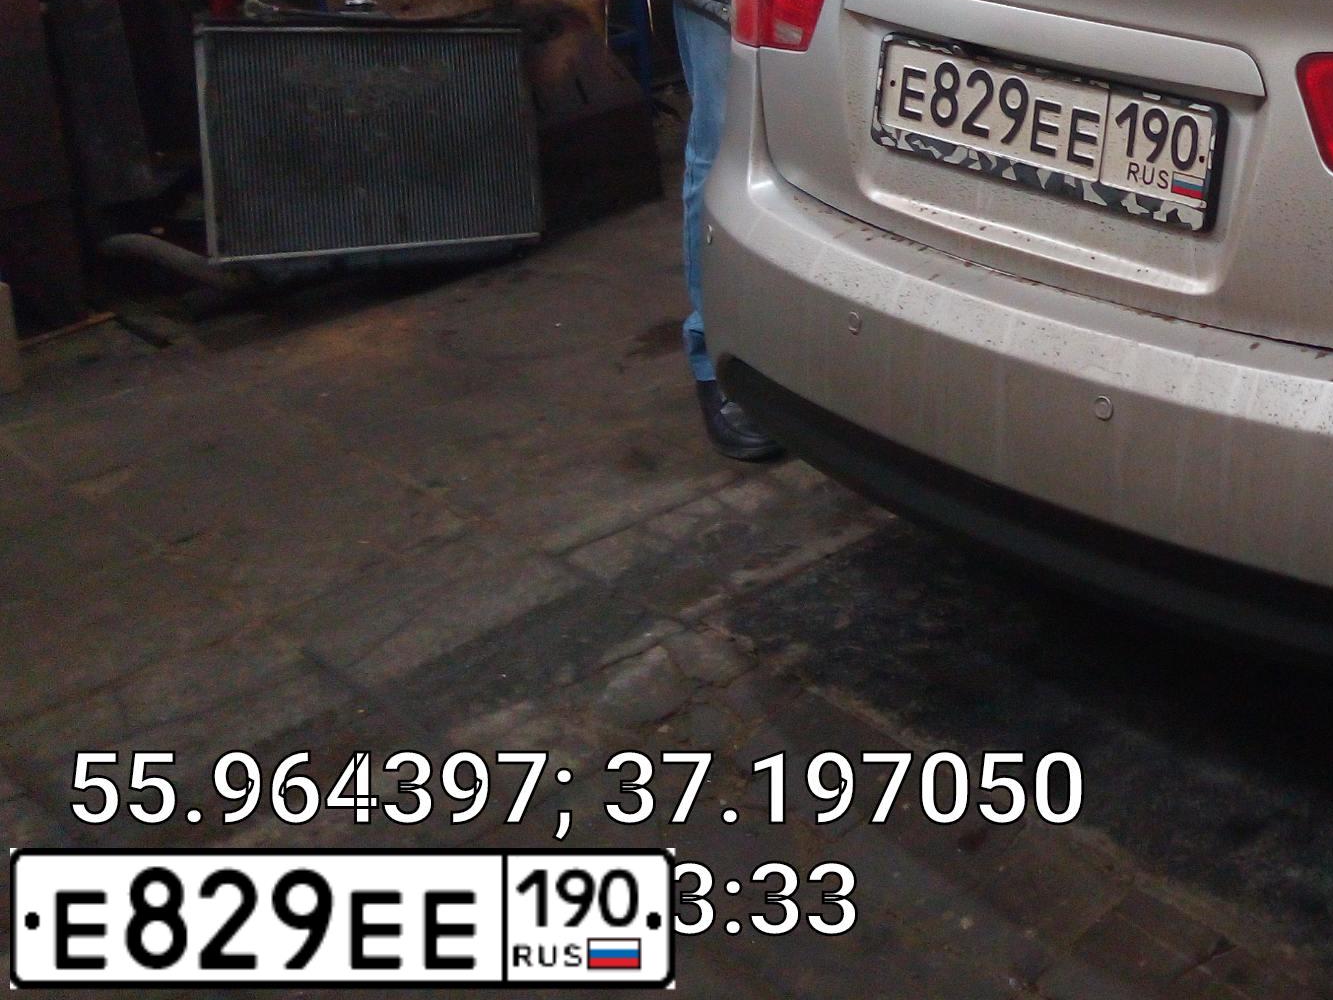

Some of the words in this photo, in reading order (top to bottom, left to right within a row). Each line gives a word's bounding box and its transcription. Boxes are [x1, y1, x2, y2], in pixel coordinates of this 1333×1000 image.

[898, 60, 1102, 169] E829EE
[1114, 101, 1201, 173] 190
[1125, 161, 1171, 191] RUS
